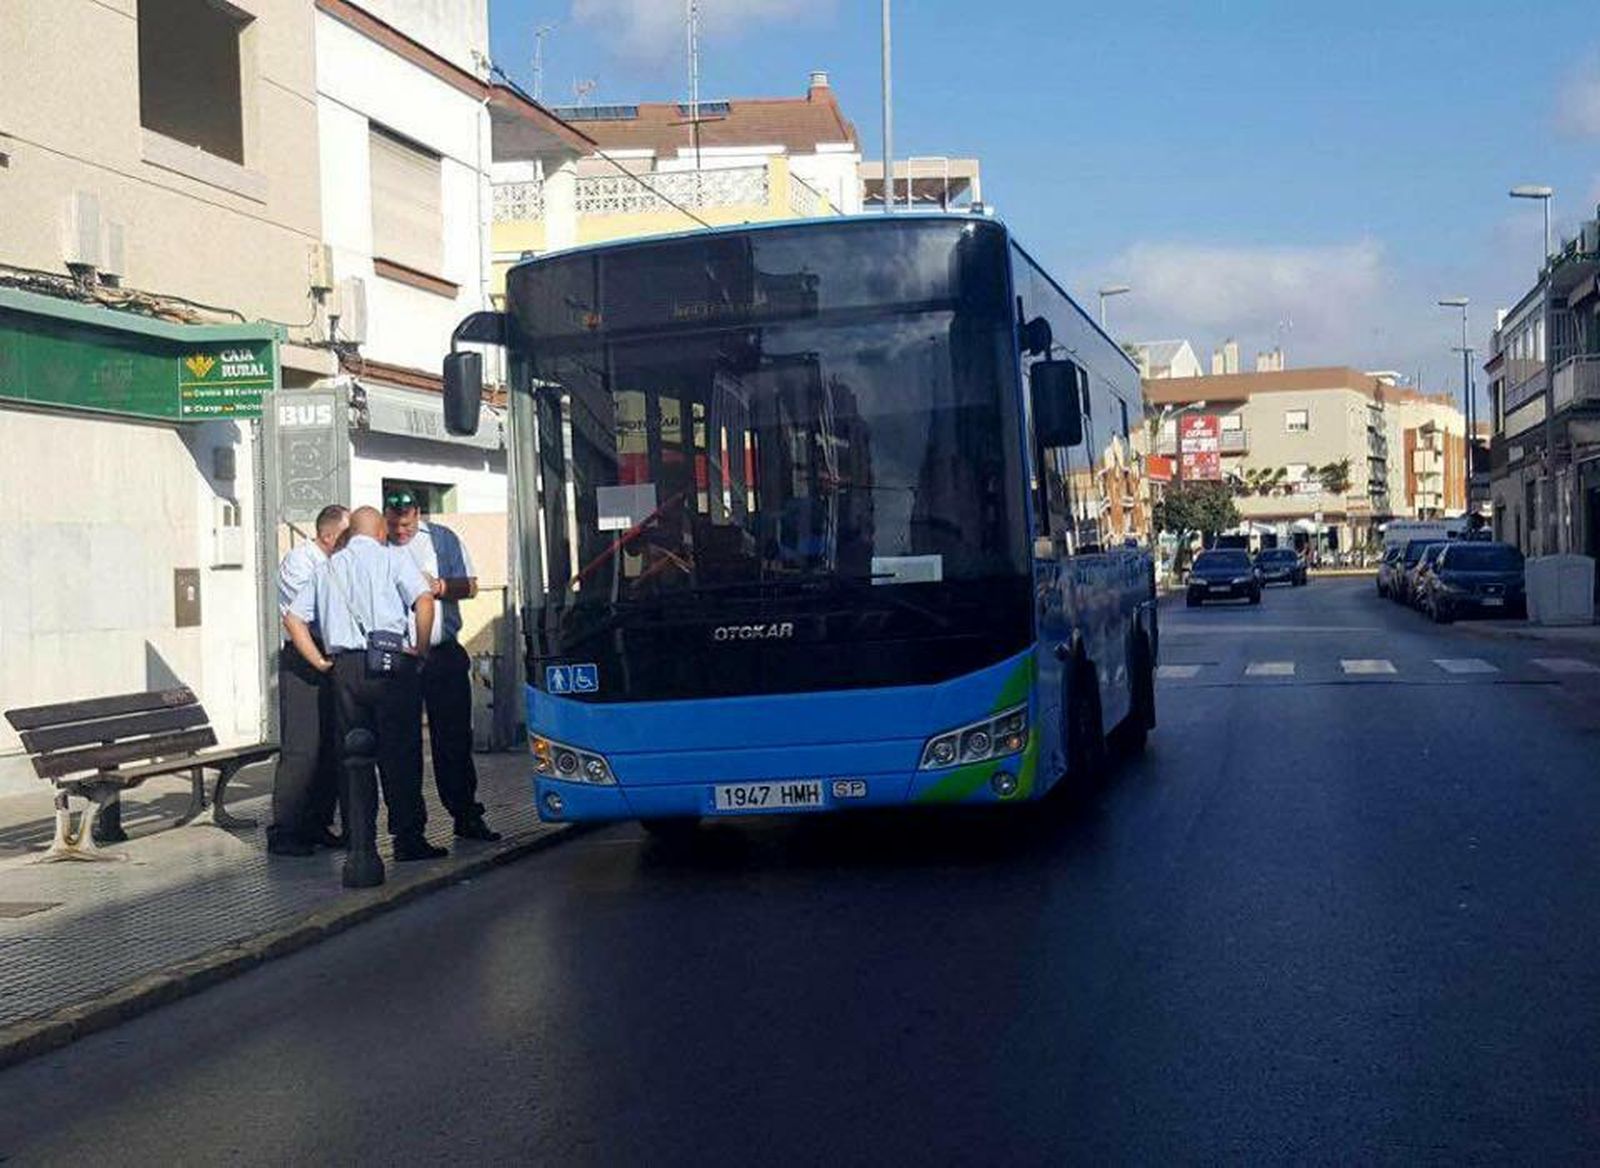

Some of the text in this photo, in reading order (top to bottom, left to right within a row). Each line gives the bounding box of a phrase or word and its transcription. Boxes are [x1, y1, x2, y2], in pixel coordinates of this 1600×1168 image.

[221, 363, 268, 377] RURAL
[279, 404, 332, 426] BUS
[714, 622, 794, 641] OTOKAR
[724, 781, 820, 806] 1947 HMH
[834, 780, 863, 796] SP
